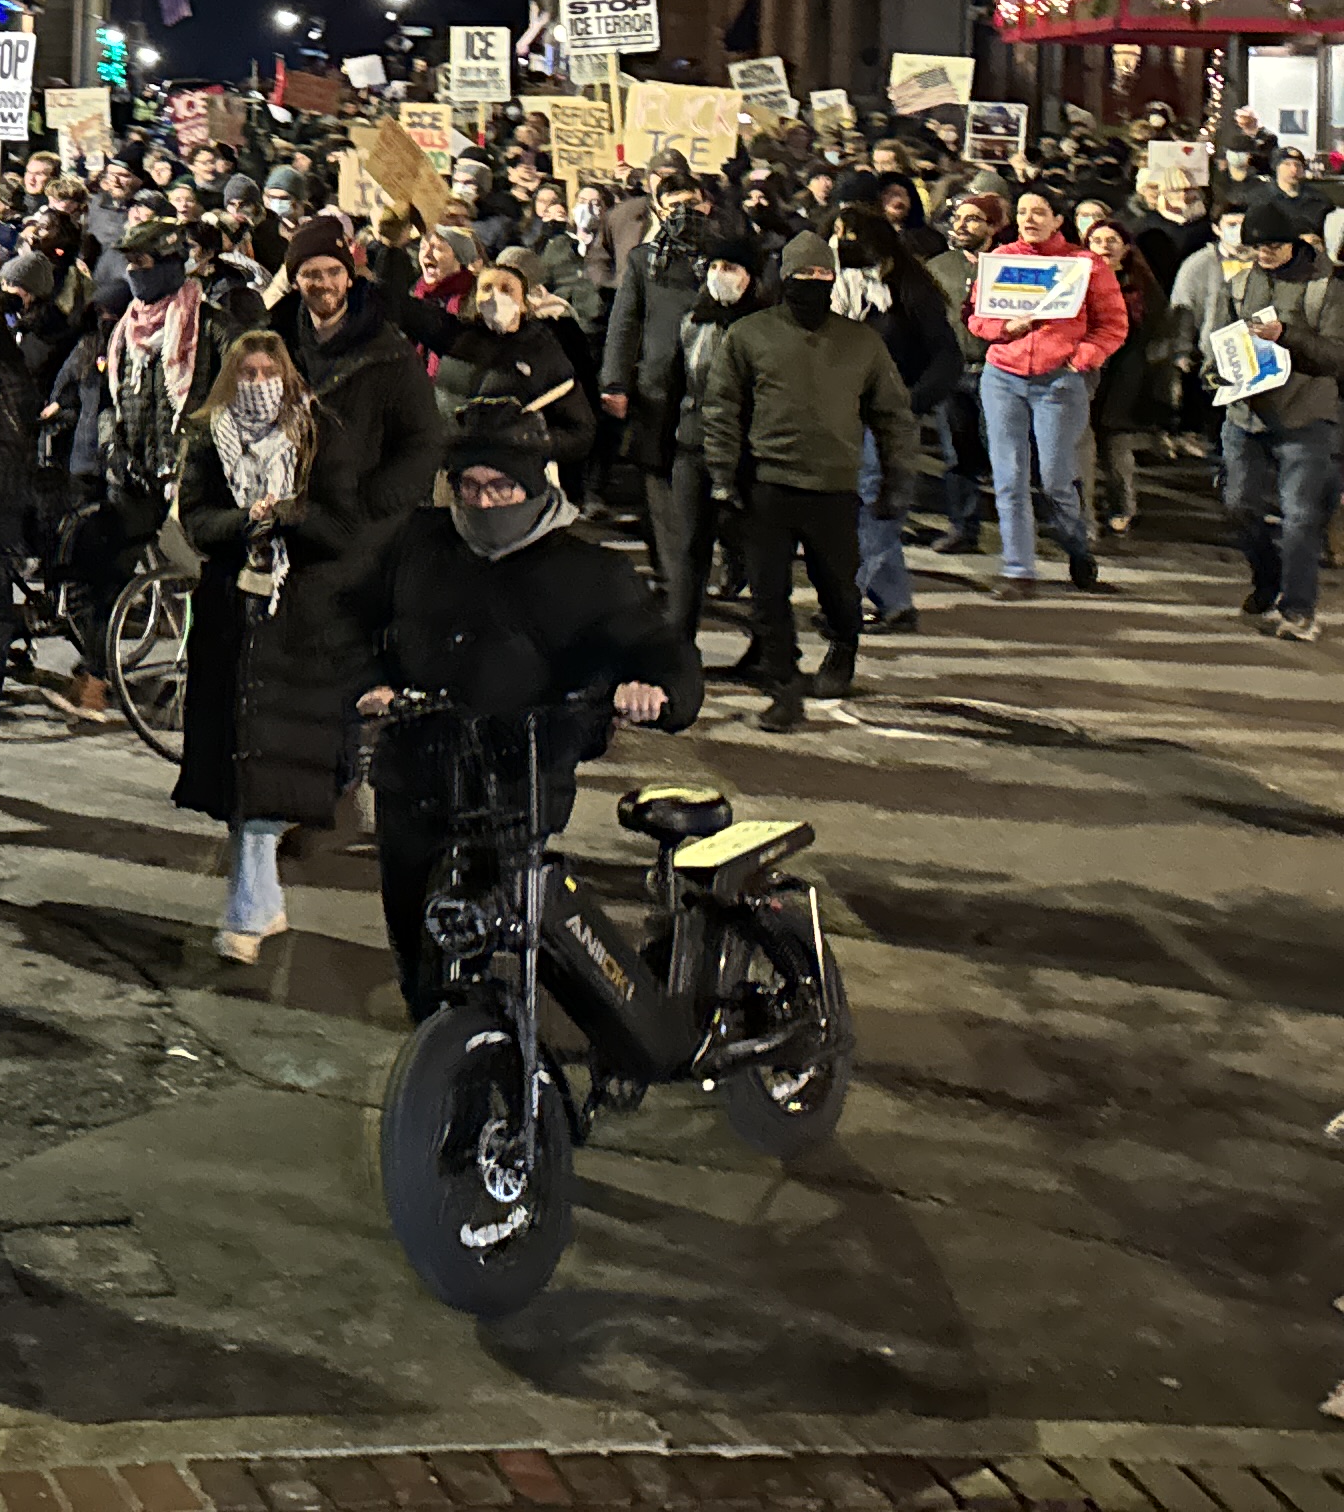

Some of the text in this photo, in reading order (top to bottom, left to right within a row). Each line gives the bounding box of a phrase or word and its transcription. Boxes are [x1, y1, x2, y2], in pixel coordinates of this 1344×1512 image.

[569, 12, 653, 37] ICE TERROR
[465, 30, 497, 61] ICE
[637, 88, 742, 137] FUCK
[645, 129, 710, 166] ICE
